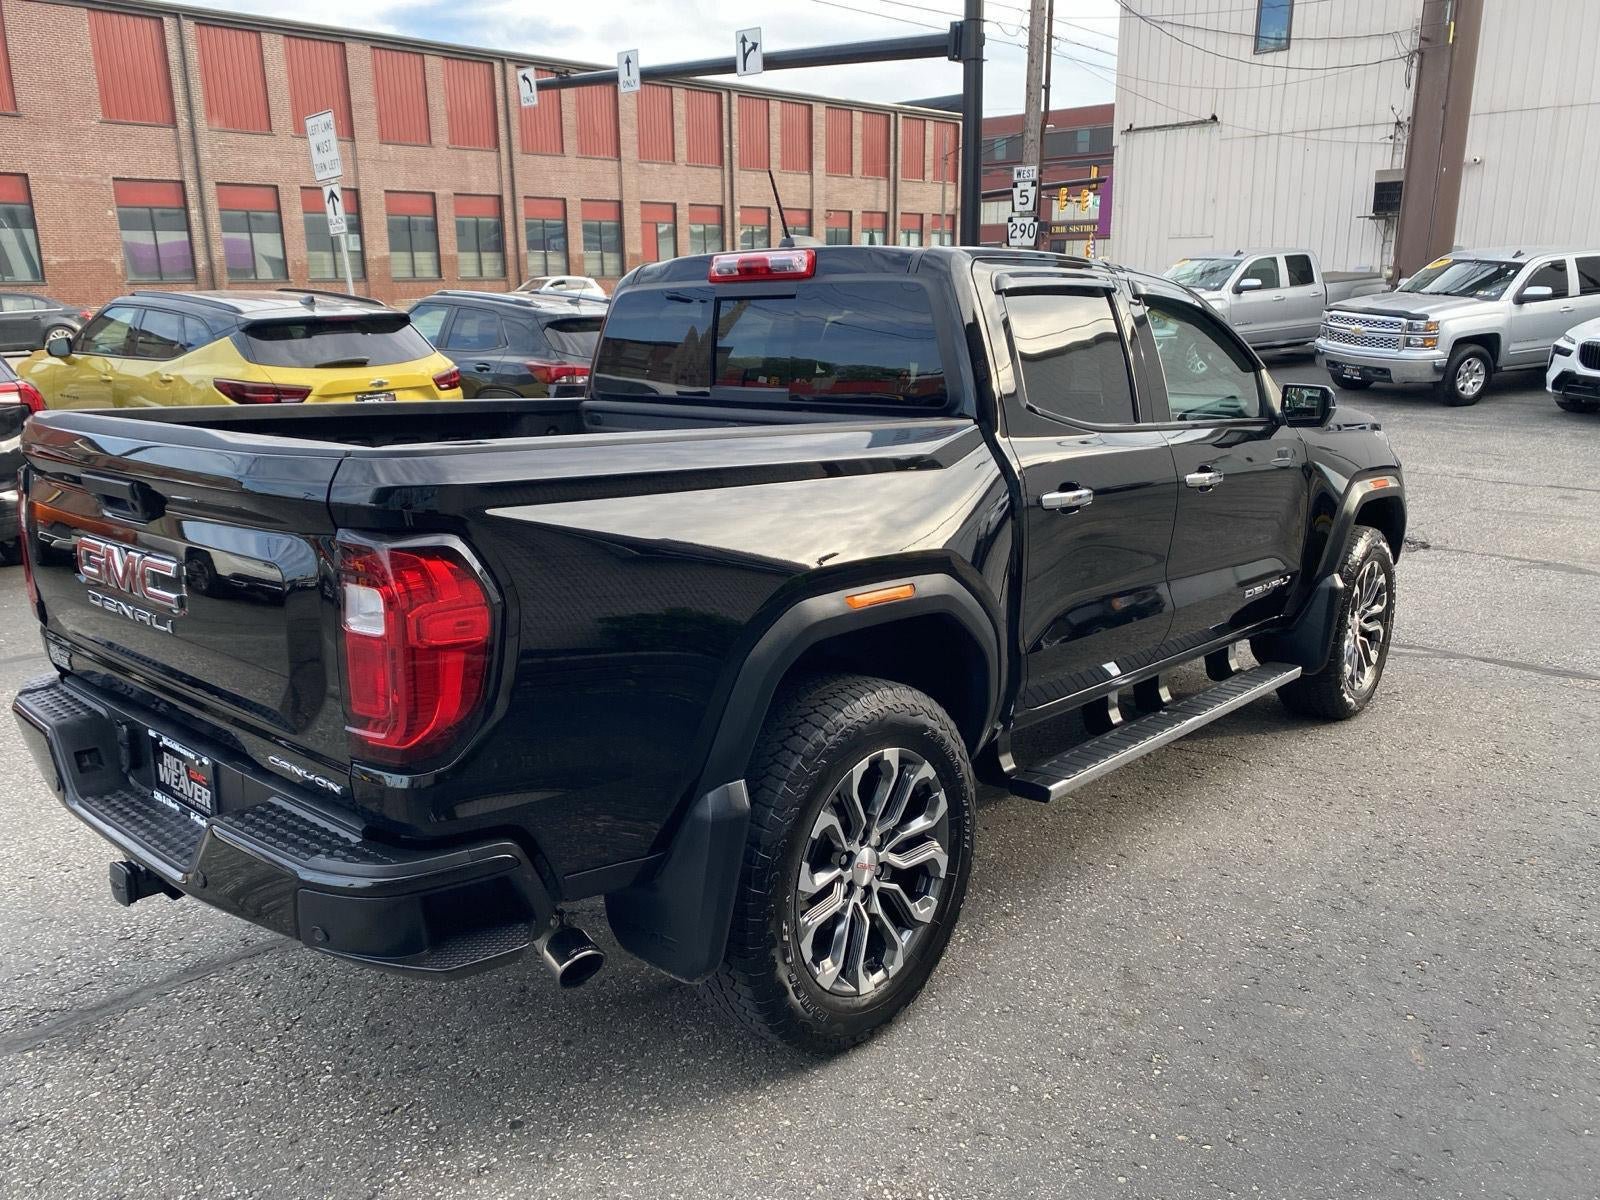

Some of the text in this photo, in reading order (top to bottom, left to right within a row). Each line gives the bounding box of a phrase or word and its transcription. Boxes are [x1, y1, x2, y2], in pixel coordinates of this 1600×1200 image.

[623, 79, 637, 89] ONLY
[523, 95, 535, 104] ONLY
[309, 119, 333, 136] LEFT LANE
[315, 139, 331, 154] MUST
[315, 158, 340, 172] TURN LEFT
[1016, 169, 1035, 179] WEST
[1019, 189, 1029, 206] 5
[1010, 223, 1036, 239] 290
[76, 535, 186, 612] GMC
[1244, 575, 1291, 599] DENALI
[87, 590, 174, 634] DENALI
[163, 751, 208, 786] RICK GMC
[267, 755, 342, 796] CANYON
[158, 762, 212, 810] WEAVER
[856, 862, 876, 872] GMC
